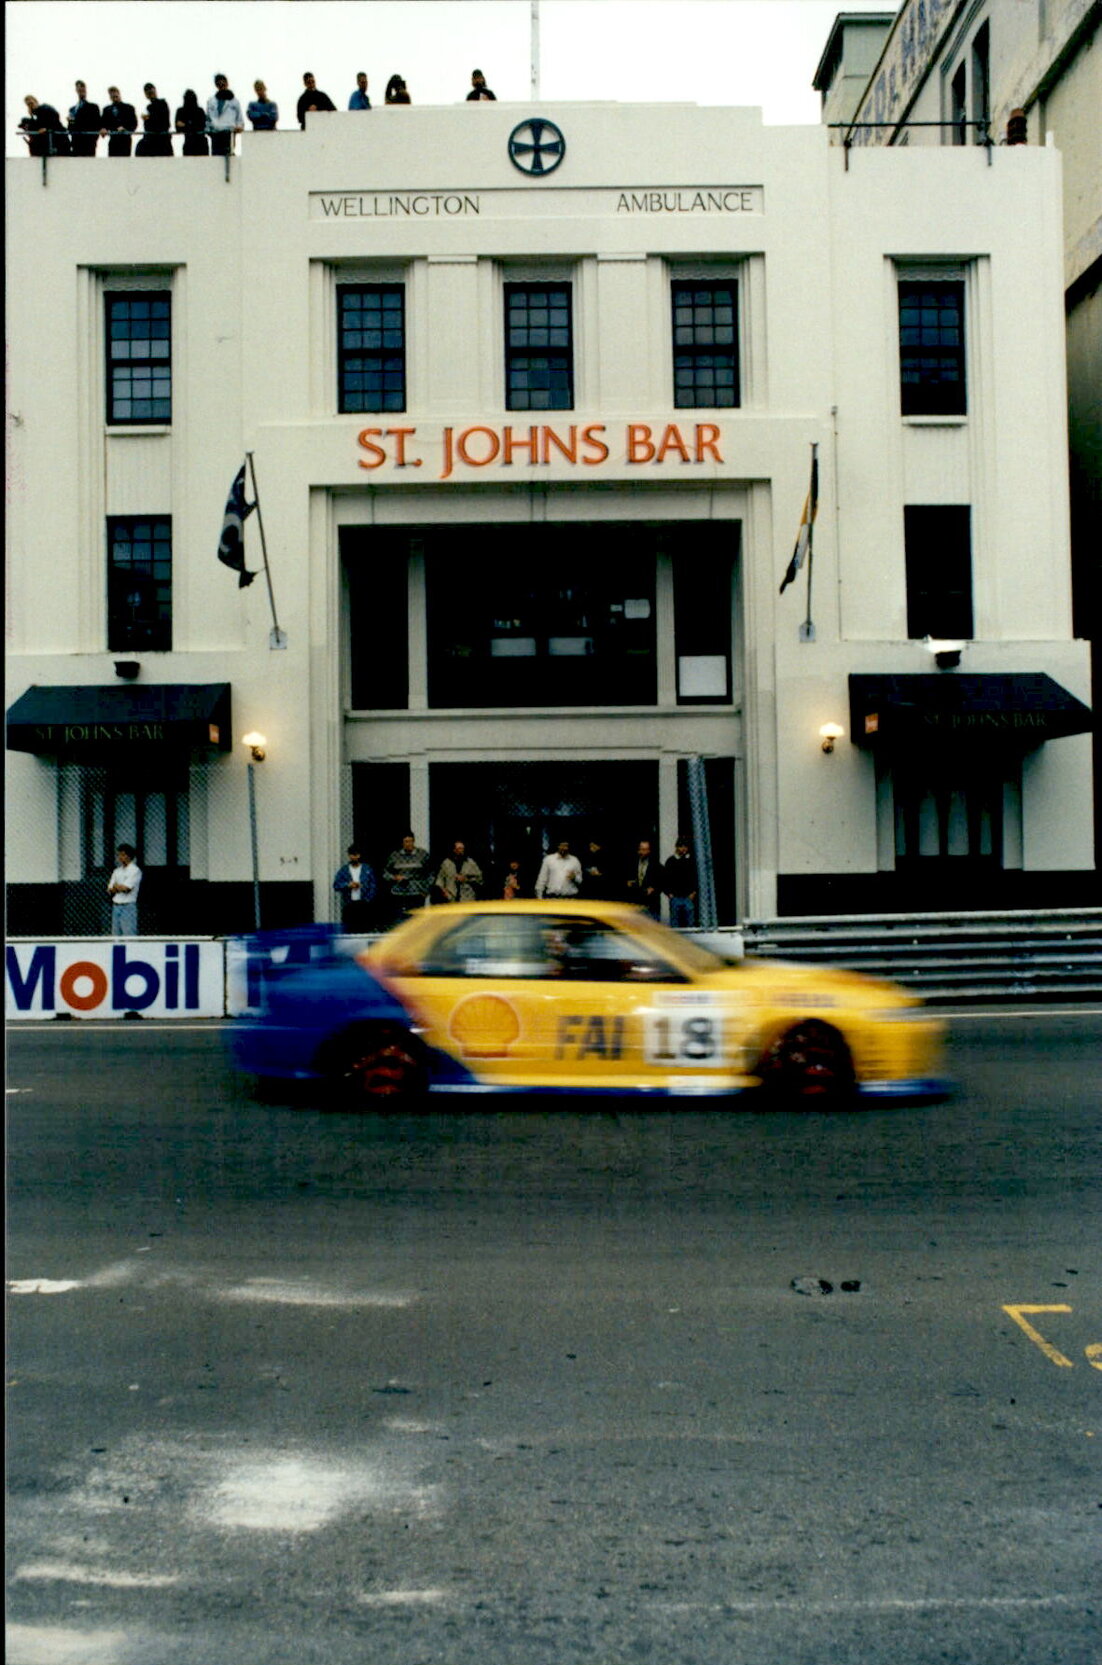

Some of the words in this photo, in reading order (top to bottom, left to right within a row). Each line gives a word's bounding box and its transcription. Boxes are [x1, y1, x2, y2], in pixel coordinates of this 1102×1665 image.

[321, 195, 480, 217] WELLINGTON
[617, 192, 753, 212] AMBULANCE
[357, 428, 422, 468] ST.
[439, 425, 609, 479] JOHNS
[626, 424, 724, 464] BAR
[64, 725, 123, 744] JOHNS
[129, 724, 164, 740] BAR
[1013, 712, 1048, 727] BAR
[6, 944, 200, 1011] Mobil
[555, 1015, 624, 1060] FAI
[652, 1017, 717, 1059] 18
